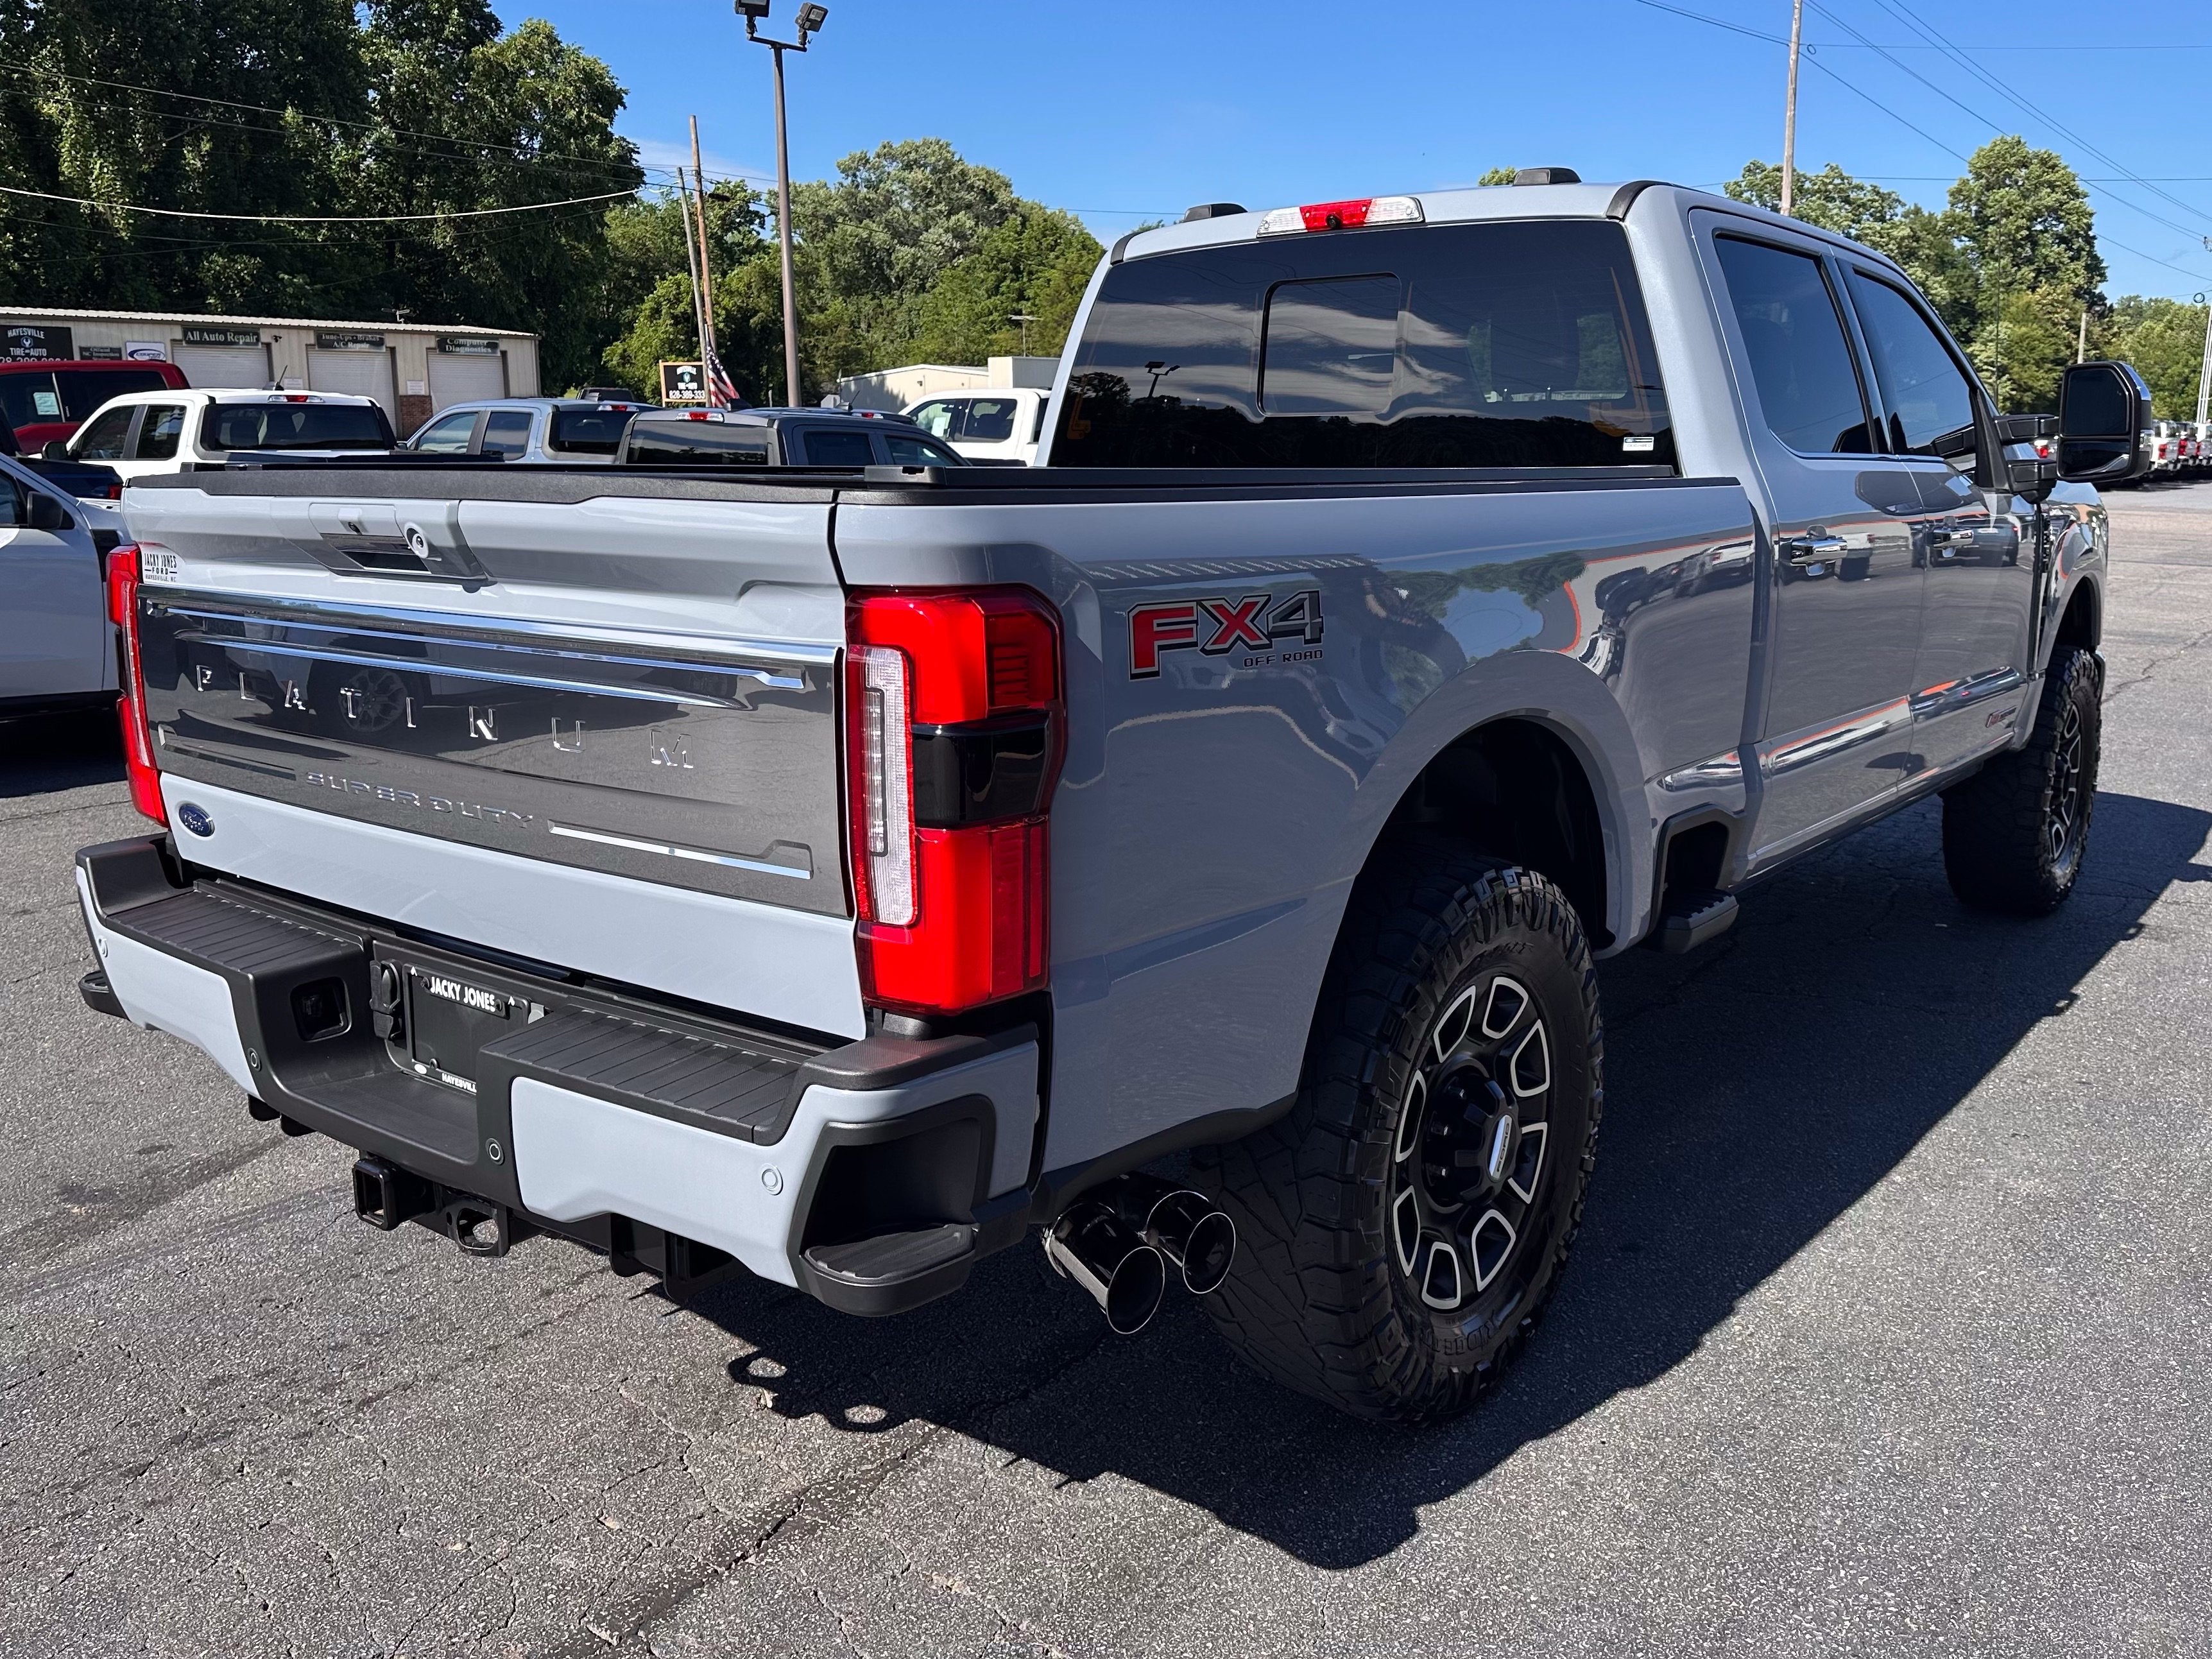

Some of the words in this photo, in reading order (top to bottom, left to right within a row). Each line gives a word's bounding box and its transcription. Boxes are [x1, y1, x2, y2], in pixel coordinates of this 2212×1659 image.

[7, 327, 46, 339] HAYESVILLE
[185, 331, 200, 341] All
[201, 331, 225, 342] Auto
[227, 332, 258, 345] Repair
[447, 338, 487, 347] Computer
[445, 344, 492, 354] Diagnostics
[144, 553, 159, 566] JACKY
[160, 554, 176, 568] JONES
[1127, 590, 1325, 681] FX4
[1244, 655, 1276, 668] OFF
[1282, 649, 1324, 664] ROAD
[196, 664, 694, 769] PLATINUM
[306, 771, 421, 807] SUPER
[428, 795, 534, 829] DUTY
[430, 976, 460, 1002] JACKY
[463, 986, 496, 1013] JONES
[442, 1073, 477, 1093] HAYESVILL
